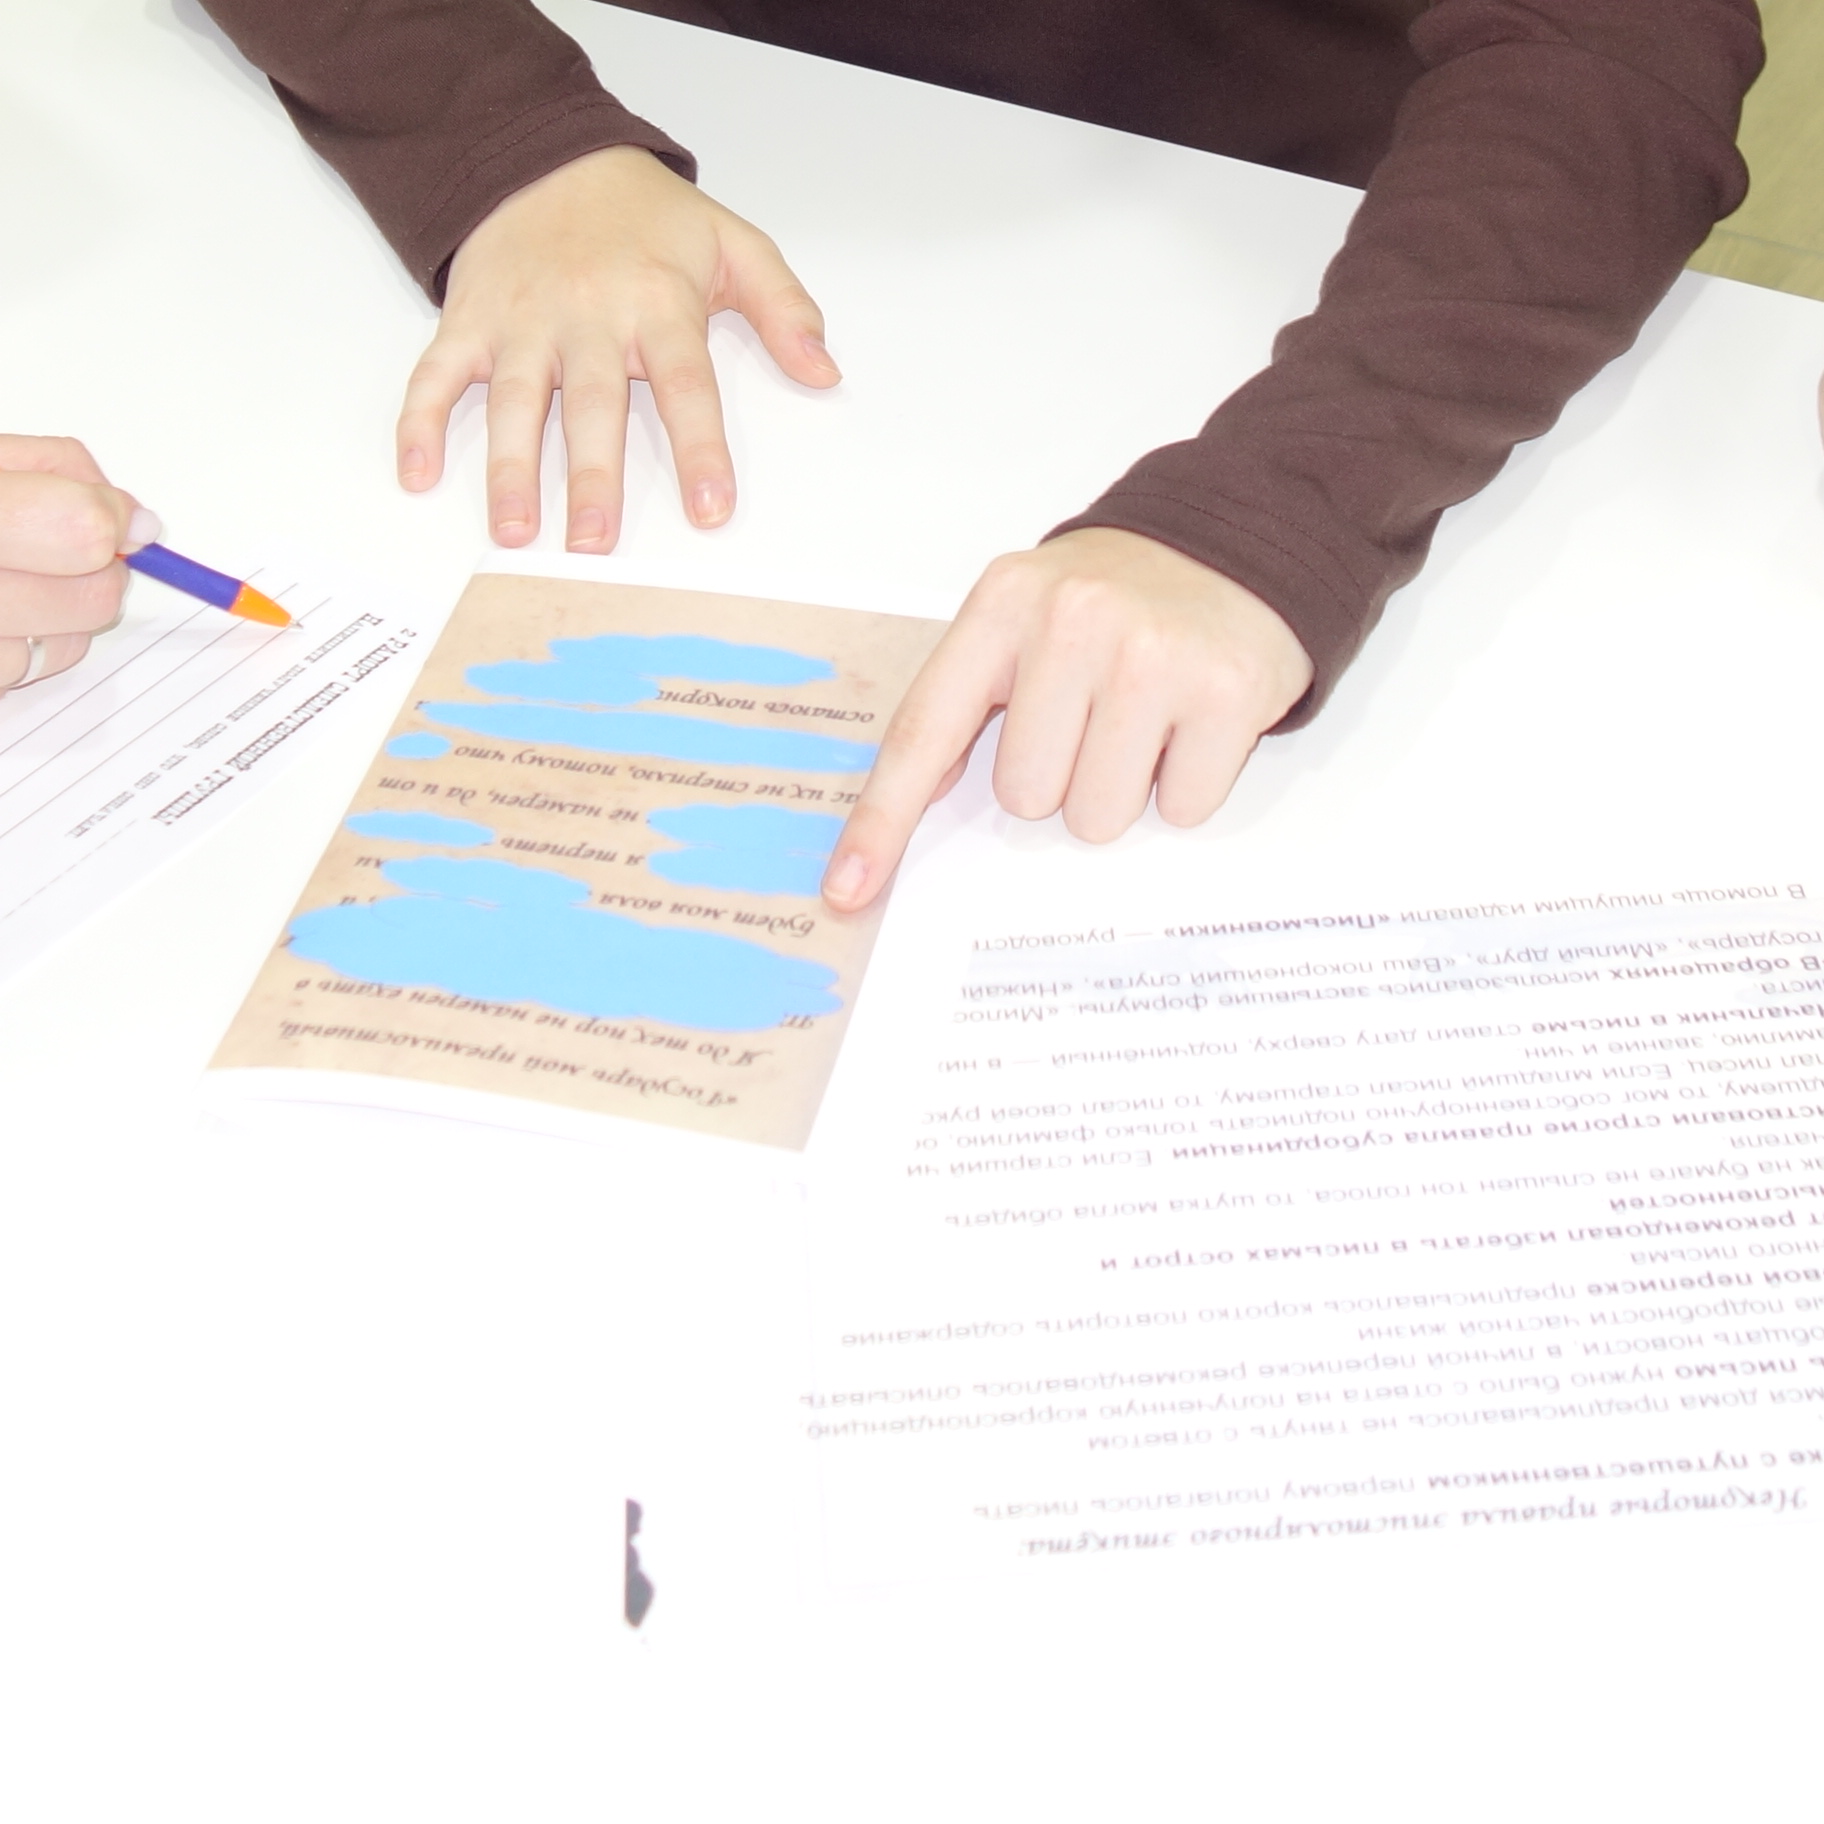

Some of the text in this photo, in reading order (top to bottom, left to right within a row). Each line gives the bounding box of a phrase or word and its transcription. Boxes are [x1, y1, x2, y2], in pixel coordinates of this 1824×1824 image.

[341, 636, 410, 683] РАПОРТ
[762, 701, 876, 725] остаюсь
[225, 681, 350, 772] СЛЕДСТВЕННОЙ
[453, 745, 861, 807] ас их не стерплю, потому что
[149, 769, 235, 827] ГРУППЫ
[376, 775, 641, 826] не намерен, да и от
[499, 836, 646, 868] я терпеть
[597, 892, 664, 913] воля
[1671, 885, 1779, 903] помощь
[1786, 883, 1807, 900] В
[668, 901, 729, 922] моя
[1400, 902, 1526, 924] издавали
[1533, 893, 1664, 914] пишущим
[292, 977, 312, 993] в
[1190, 961, 1374, 988] покорнейший
[1218, 955, 1791, 1007] обращениях использовались застывшие
[316, 979, 404, 1002] ехать
[407, 989, 530, 1024] намерен
[534, 1013, 569, 1031] не
[573, 1016, 628, 1042] пор
[1426, 1024, 1522, 1041] ставил
[1531, 1015, 1641, 1035] письме
[629, 1025, 690, 1053] тех
[1356, 1028, 1417, 1046] дату
[1607, 1036, 1703, 1054] звание
[277, 1019, 739, 1109] «Государь мой премилостивый,
[695, 1043, 730, 1066] до
[1461, 1068, 1593, 1090] младший
[1601, 1063, 1673, 1080] Если
[1369, 1077, 1452, 1095] писал
[1624, 1088, 1670, 1103] мог
[990, 1104, 1072, 1121] своей
[1082, 1097, 1165, 1115] писал
[1365, 1092, 1611, 1120] собственноручно
[1105, 1120, 1198, 1137] только
[1209, 1109, 1356, 1131] подписать
[949, 1112, 1662, 1175] строгие правила Если старший
[1649, 1159, 1750, 1181] бумаге
[1421, 1181, 1466, 1196] тон
[1479, 1173, 1596, 1193] слышен
[1073, 1201, 1158, 1218] могла
[1168, 1191, 1255, 1212] шутка
[944, 1208, 1063, 1227] обидеть
[1132, 1208, 1797, 1270] рекомендовал избегать письмах острот
[1586, 1270, 1754, 1297] переписке
[1323, 1281, 1576, 1312] предписывалось
[1035, 1311, 1187, 1331] повторить
[1198, 1300, 1313, 1320] коротко
[1589, 1298, 1785, 1326] подробности
[841, 1321, 1024, 1345] содержание
[1357, 1323, 1446, 1341] жизни
[1459, 1314, 1580, 1335] частной
[1258, 1351, 1416, 1377] переписке
[1427, 1346, 1534, 1367] личной
[972, 1361, 1247, 1395] рекомендовалось
[1099, 1357, 1798, 1417] письмо нужно было ответа полученную
[799, 1386, 961, 1408] описывать
[1679, 1387, 1758, 1409] дома
[1408, 1393, 1670, 1427] предписывалось
[1250, 1418, 1347, 1438] тянуть
[1088, 1430, 1212, 1451] ответом
[1427, 1450, 1749, 1490] путешественником
[1283, 1475, 1415, 1499] первому
[1090, 1487, 1270, 1510] полагалось
[1609, 1486, 1808, 1517] Некоторые
[973, 1501, 1079, 1519] писать
[1460, 1494, 1598, 1527] правила
[1189, 1513, 1442, 1545] эпистолярного
